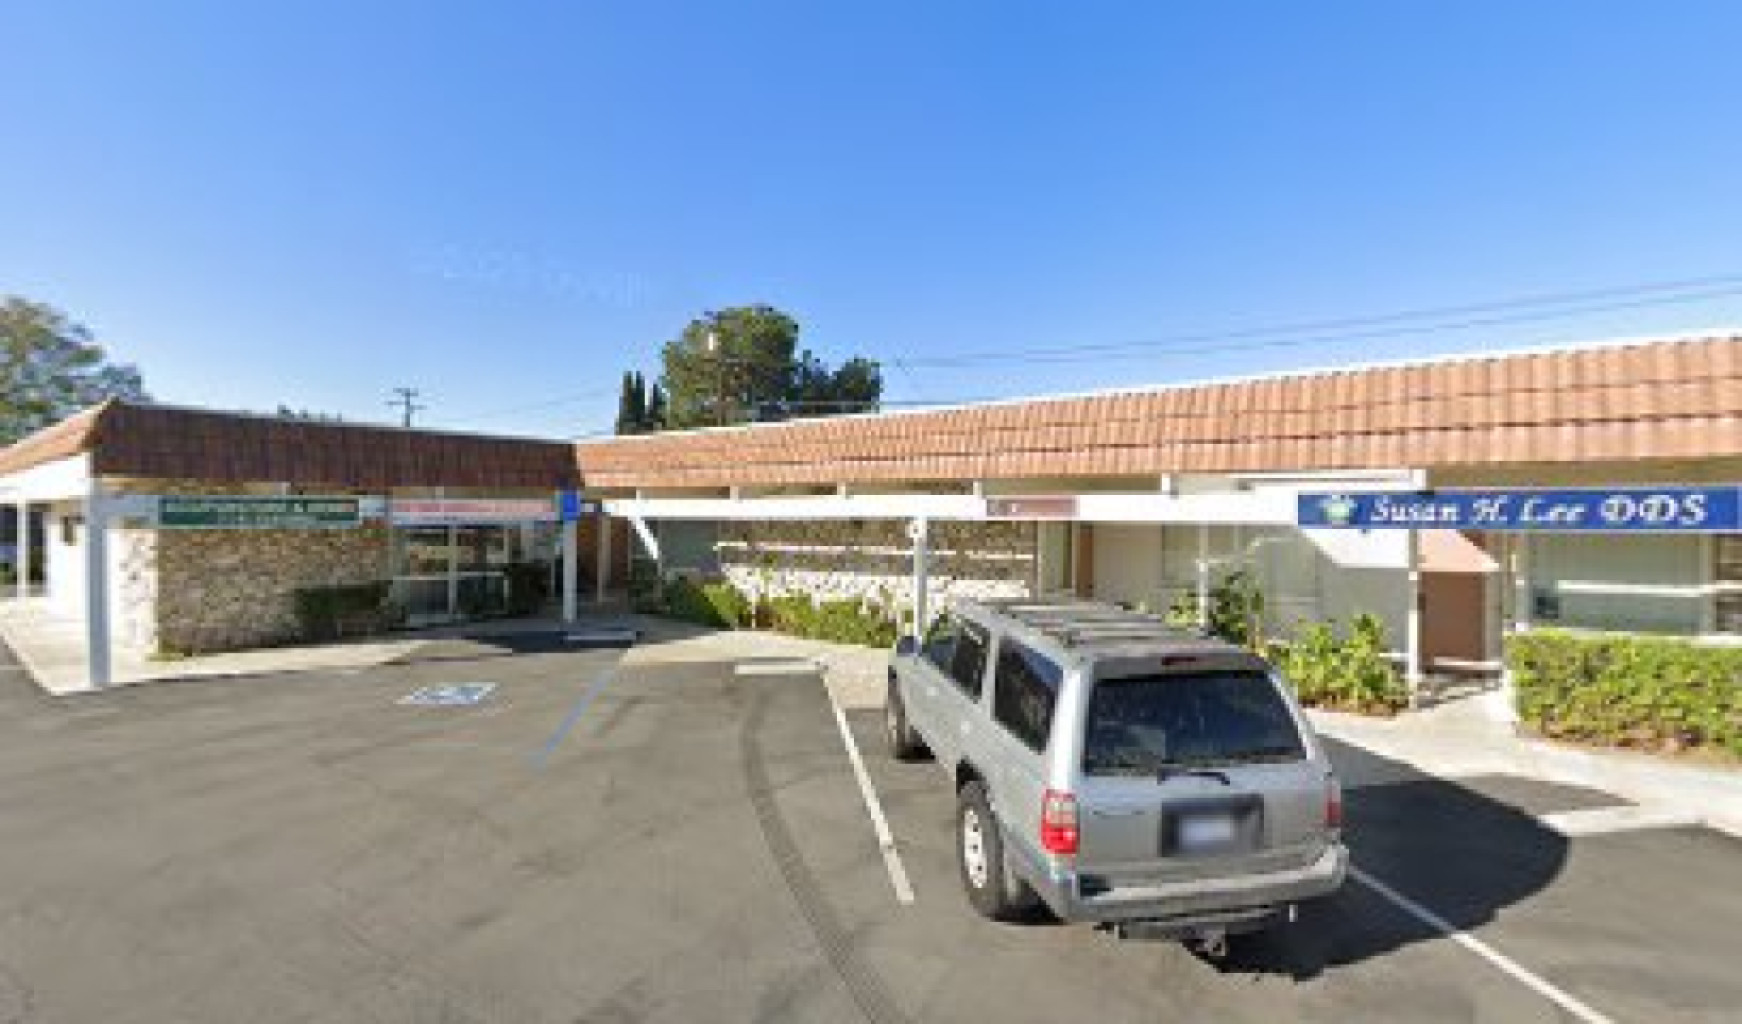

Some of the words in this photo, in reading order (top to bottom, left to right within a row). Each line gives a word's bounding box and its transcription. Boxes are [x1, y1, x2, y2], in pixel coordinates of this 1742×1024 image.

[1370, 495, 1460, 521] Susan
[1519, 495, 1585, 522] Lee
[1600, 494, 1708, 525] DDS
